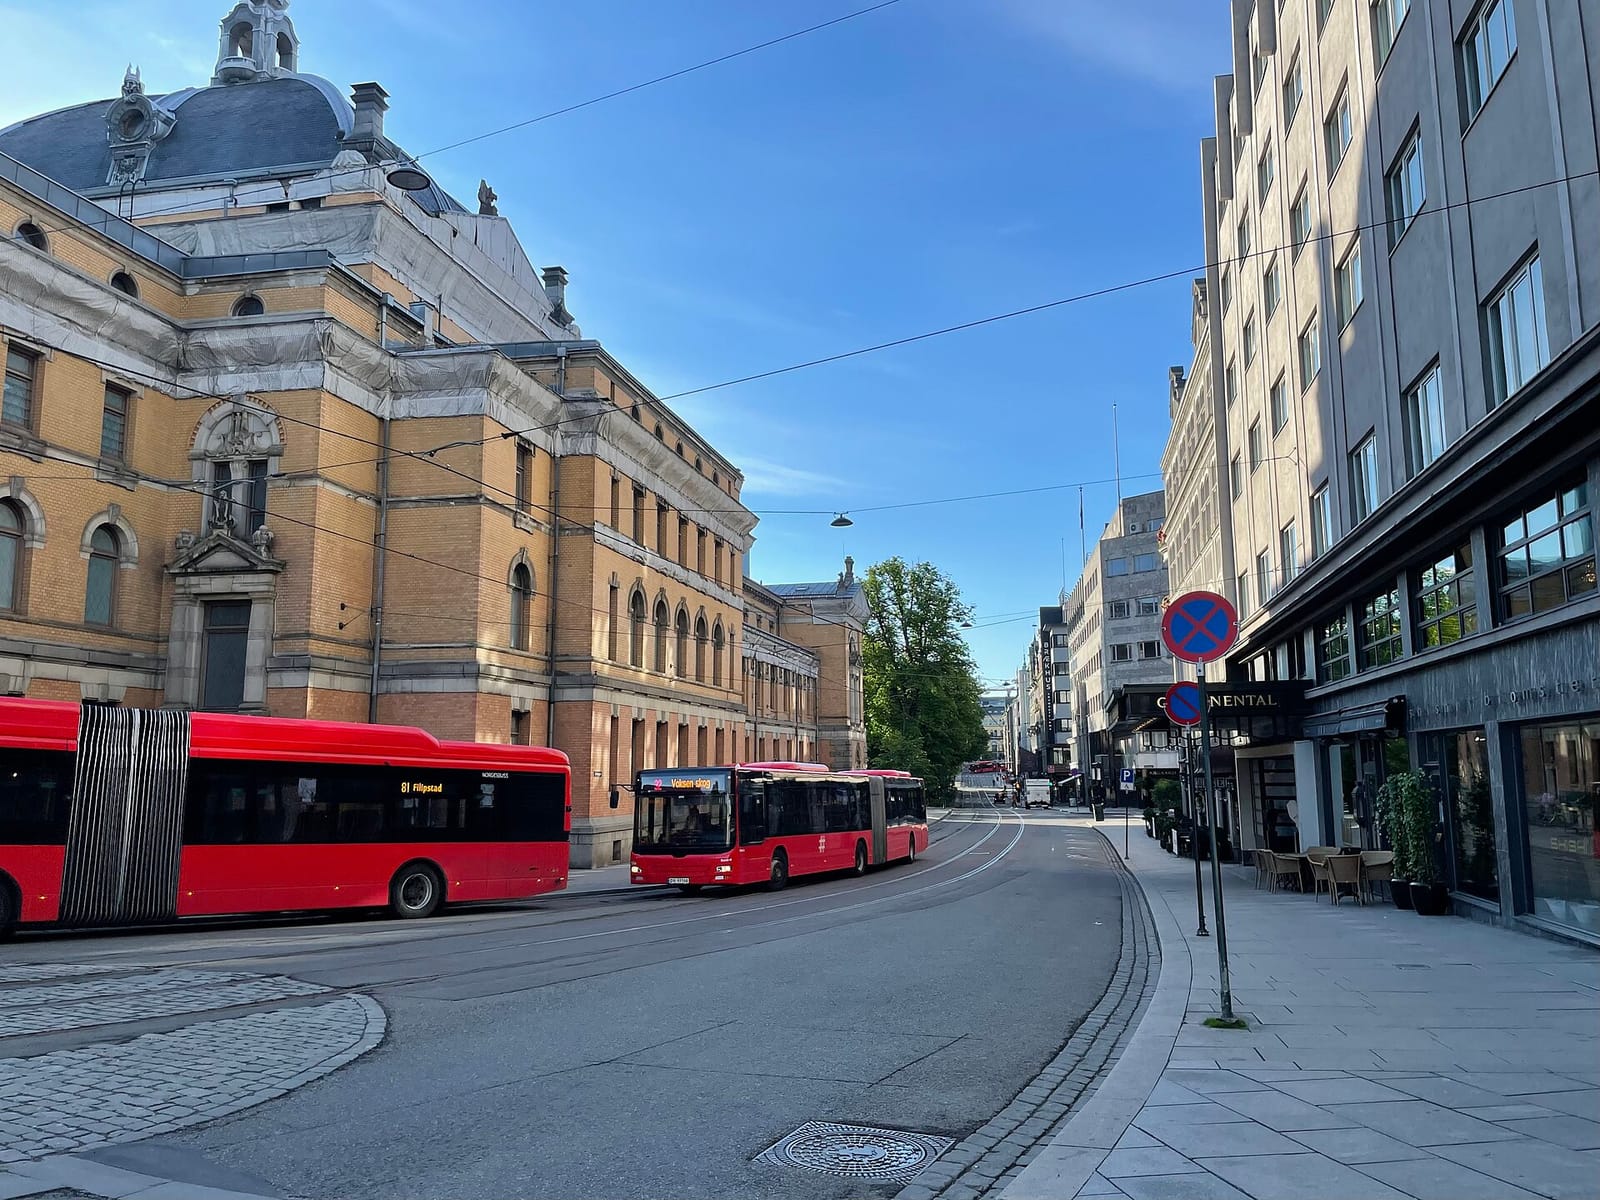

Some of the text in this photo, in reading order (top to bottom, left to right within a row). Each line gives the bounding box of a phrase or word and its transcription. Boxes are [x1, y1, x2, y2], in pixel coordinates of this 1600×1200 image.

[1156, 694, 1278, 708] CNENTAL
[1123, 770, 1131, 781] P
[401, 782, 443, 794] 81 Filipstad
[671, 778, 694, 789] Voksen
[695, 778, 711, 790] skog
